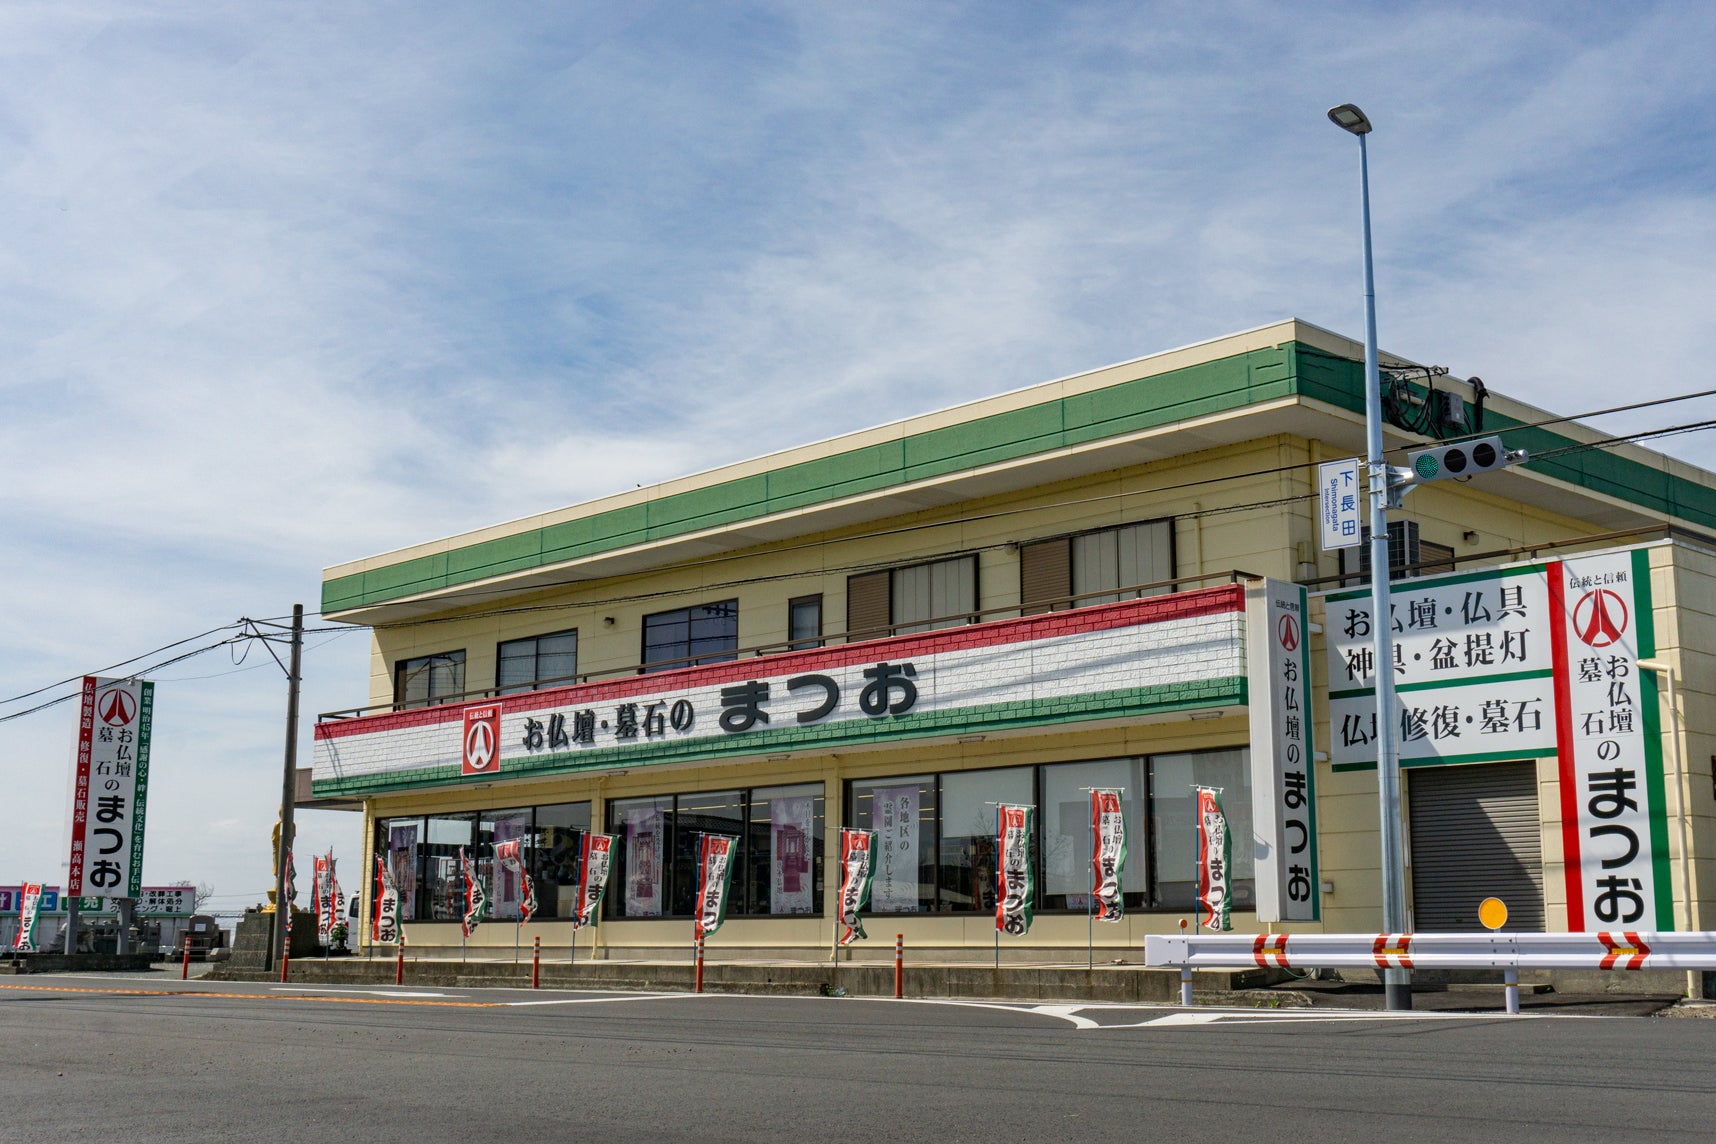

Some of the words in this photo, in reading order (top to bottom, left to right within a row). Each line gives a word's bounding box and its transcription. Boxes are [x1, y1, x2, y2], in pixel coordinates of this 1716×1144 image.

[1330, 478, 1339, 532] Shimonagata
[1340, 470, 1356, 536] 下長田
[1569, 570, 1628, 589] 伝統と信頼
[522, 699, 694, 752] お仏壇・墓石の
[719, 662, 918, 733] まつお
[1283, 657, 1301, 765] お仏壇の
[1340, 697, 1542, 747] 仏修復・墓石
[1605, 655, 1634, 734] お仏壇
[115, 728, 133, 777] お仏壇
[90, 795, 125, 888] まつお
[1284, 770, 1311, 902] まつお
[1588, 767, 1645, 924] まつお
[381, 898, 396, 942] まつお
